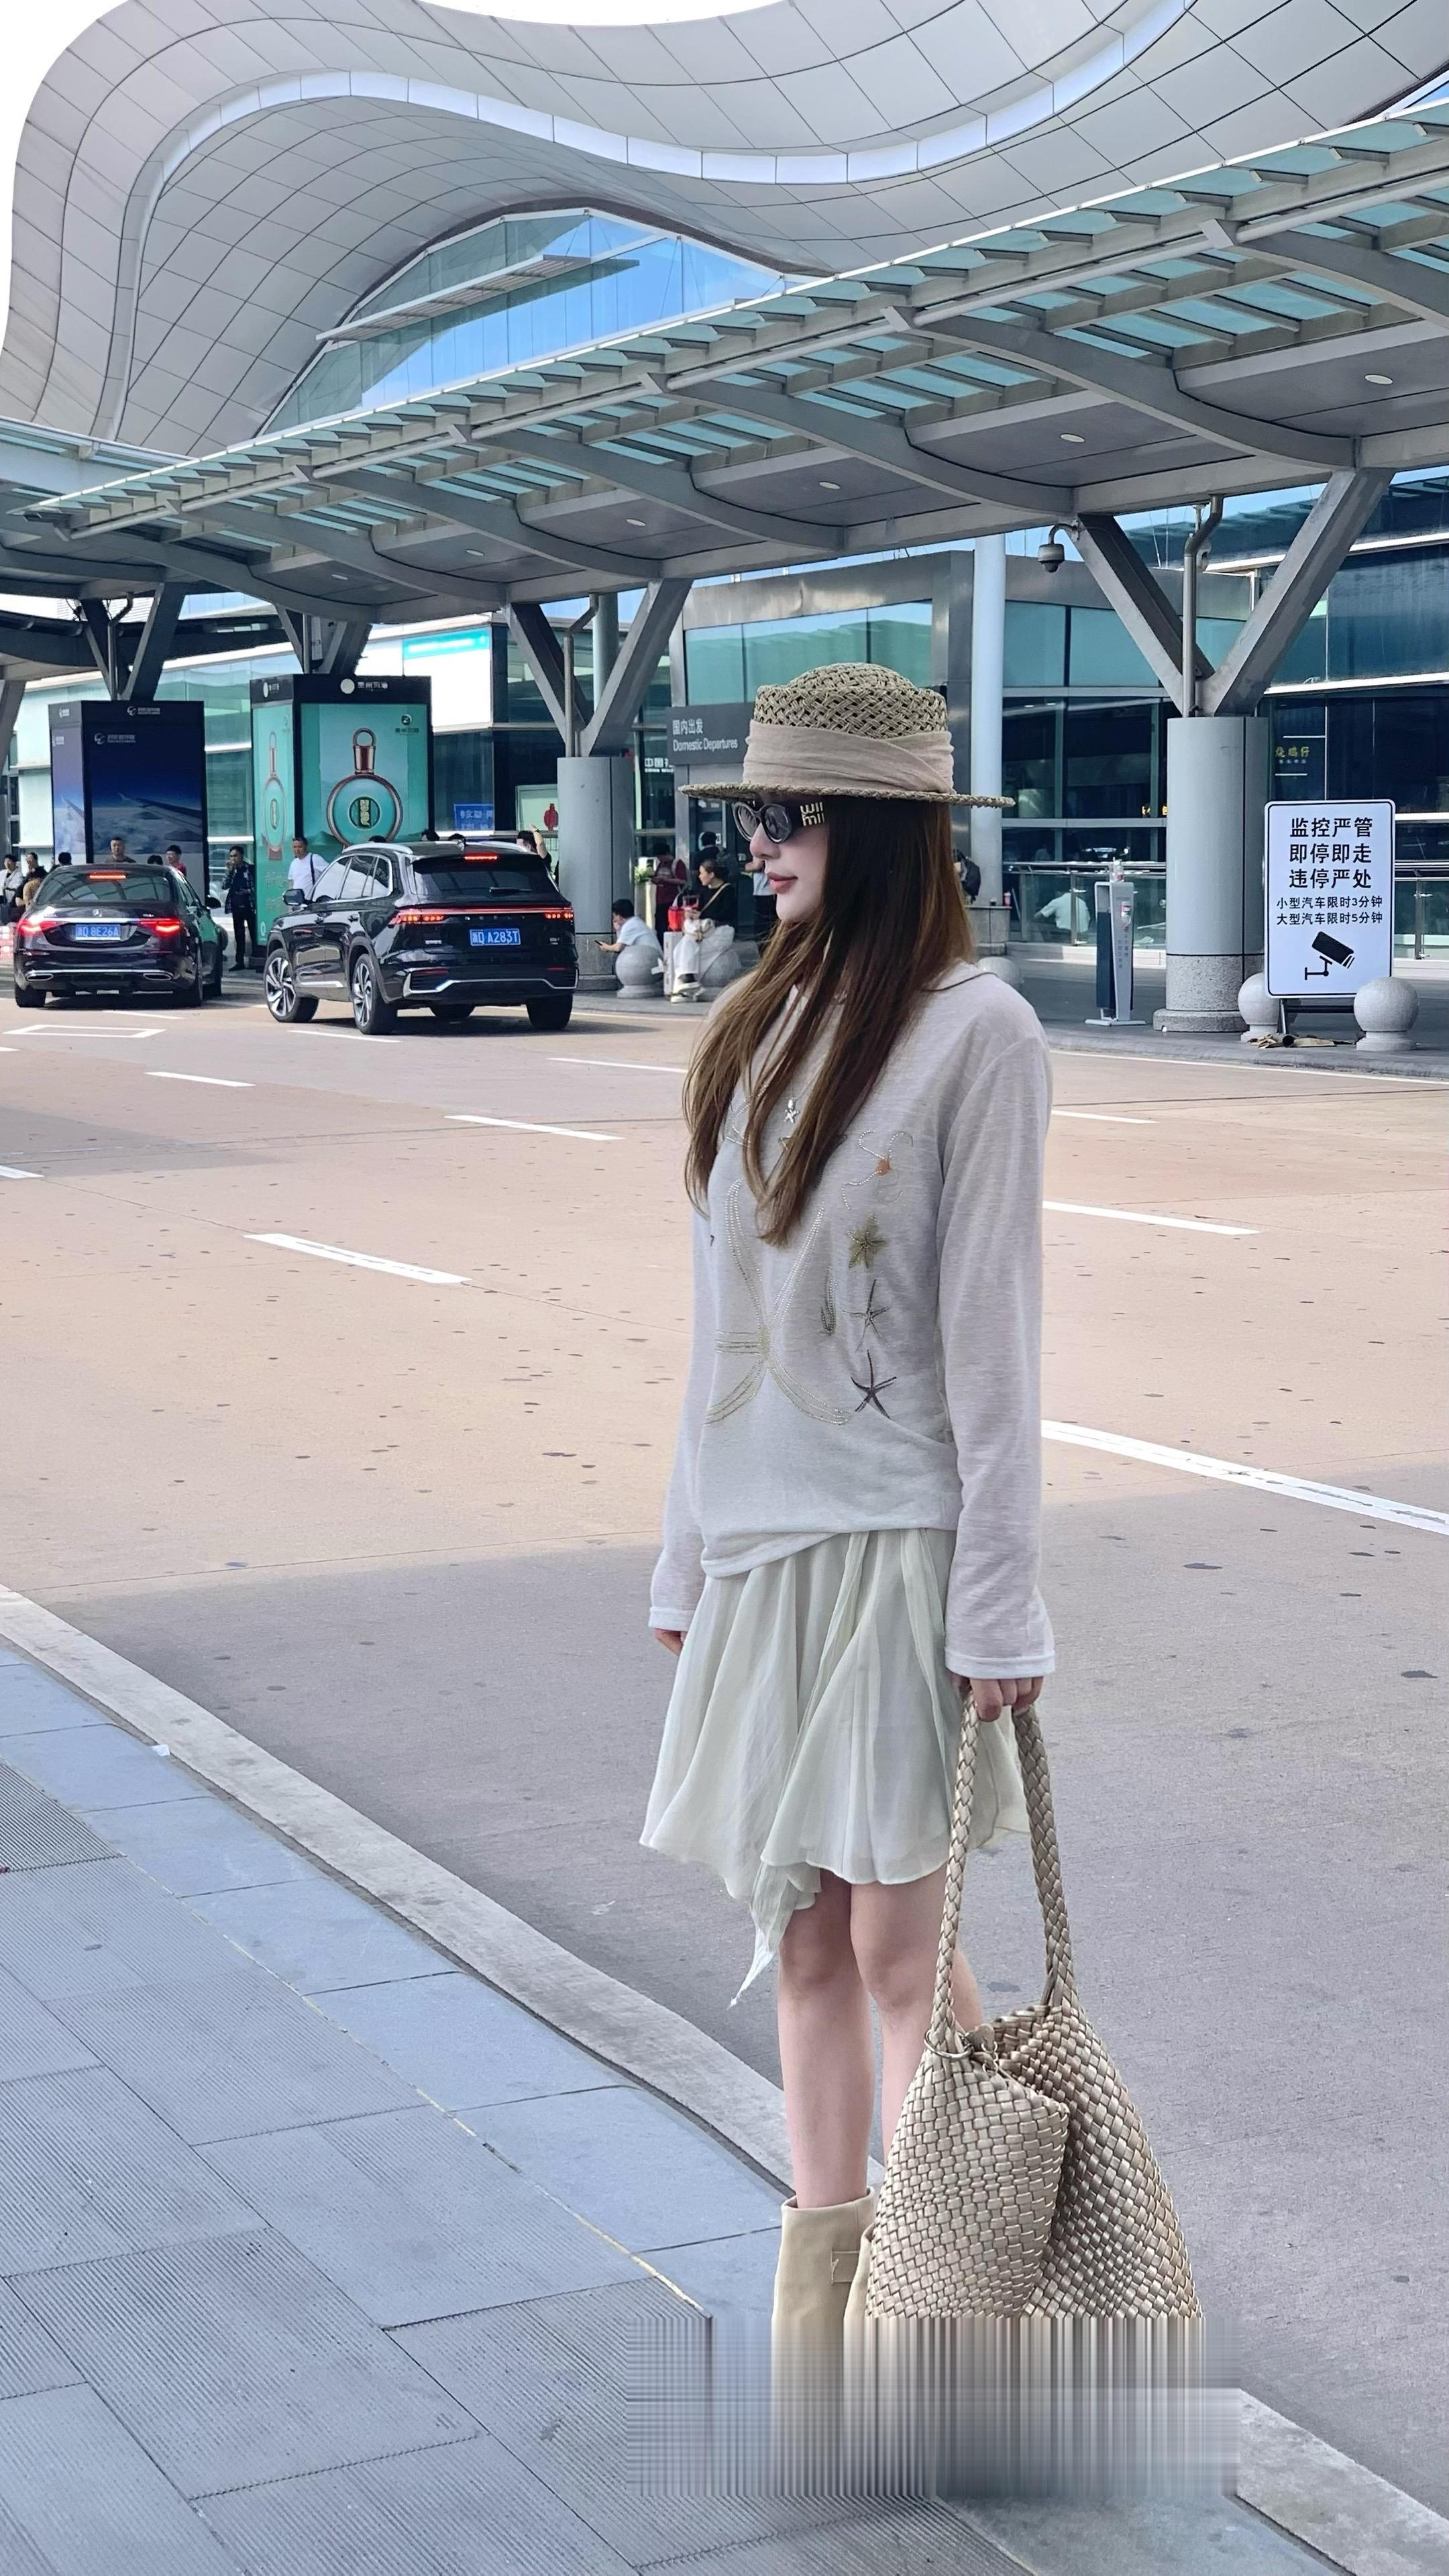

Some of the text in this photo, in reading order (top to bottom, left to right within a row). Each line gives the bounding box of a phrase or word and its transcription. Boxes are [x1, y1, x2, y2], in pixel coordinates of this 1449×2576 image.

[672, 718, 703, 735] 国内出发
[673, 738, 738, 752] Domestic Departures
[1289, 817, 1373, 837] 监控严管
[1289, 843, 1372, 863] 即停即走
[1289, 868, 1372, 888] 违停严处
[1277, 895, 1383, 909] 小型汽车限时3分钟
[1277, 912, 1383, 925] 大型汽车限时5分钟
